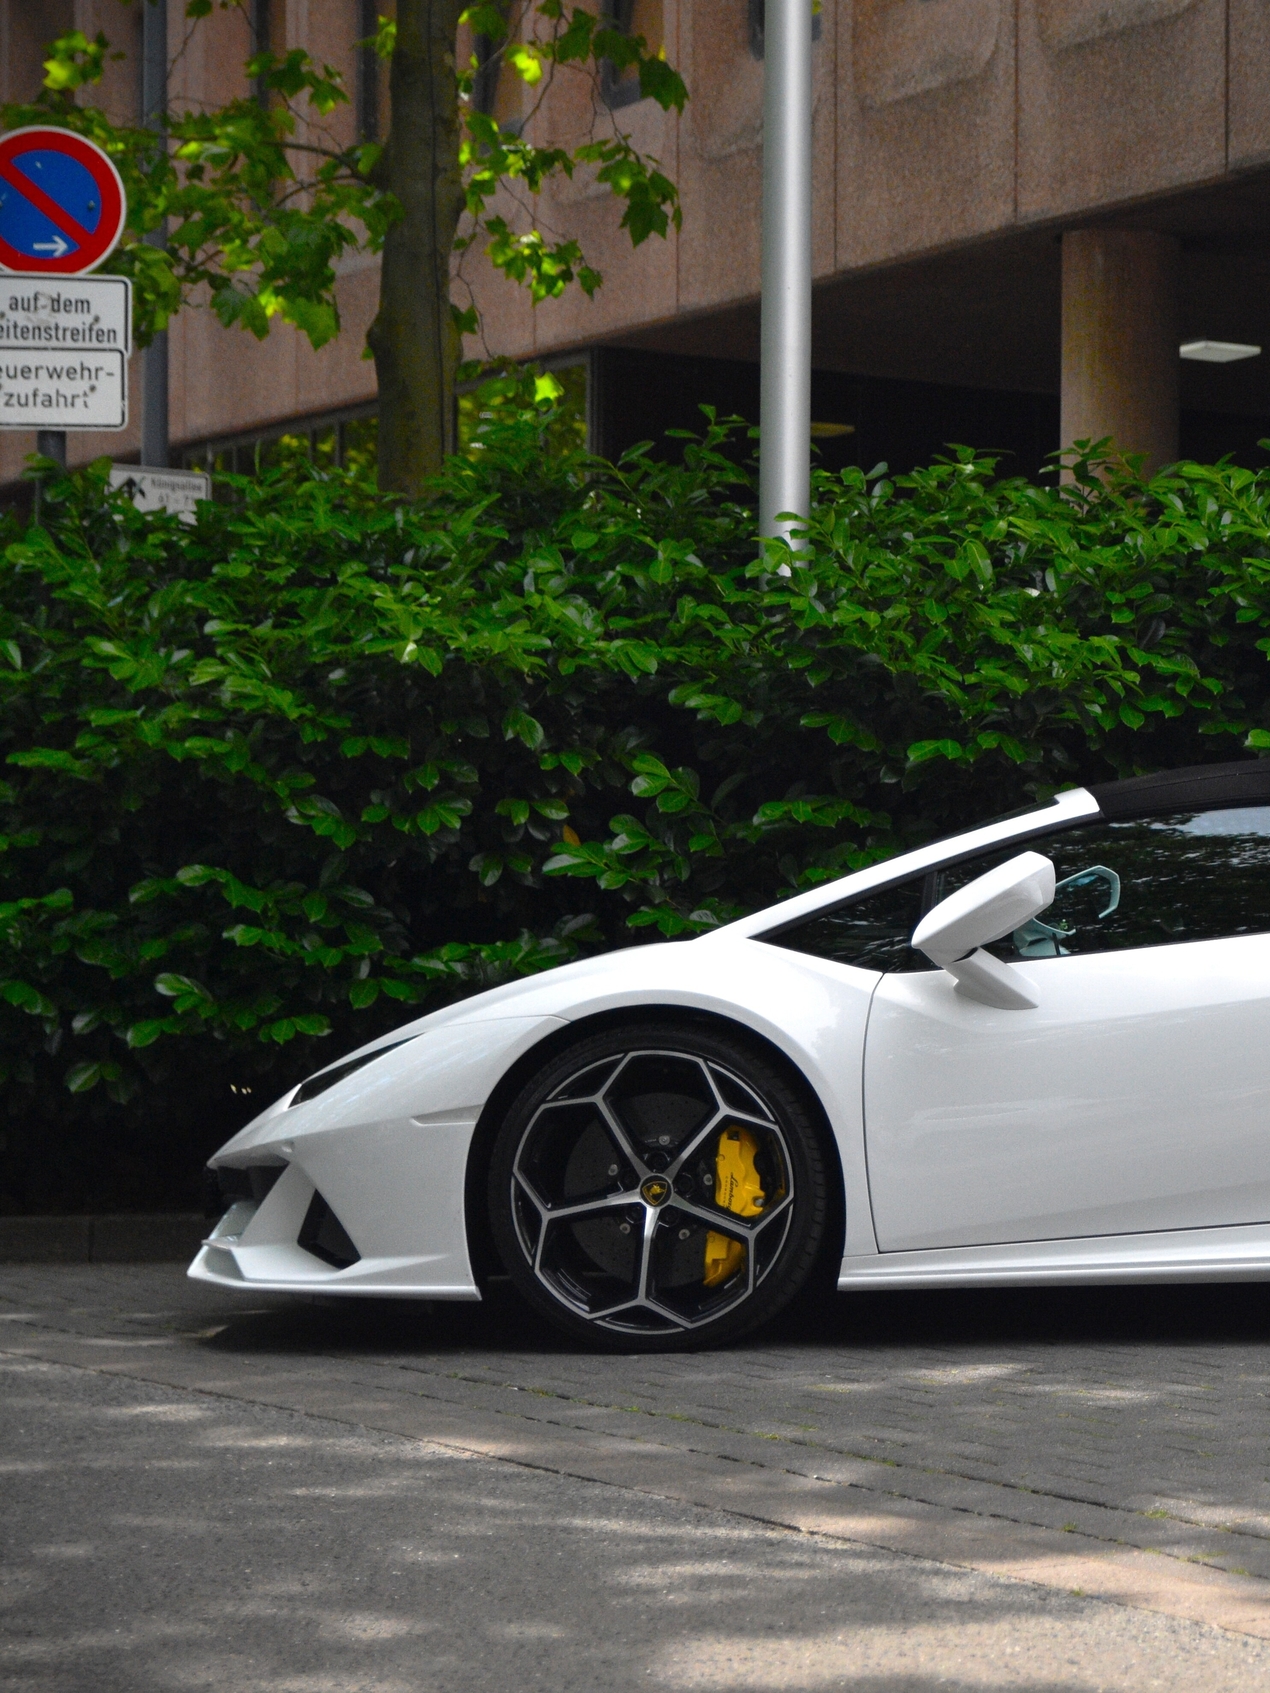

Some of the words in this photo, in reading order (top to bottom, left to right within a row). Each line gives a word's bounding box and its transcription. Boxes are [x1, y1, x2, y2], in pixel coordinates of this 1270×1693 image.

[9, 291, 40, 313] auf
[51, 292, 91, 314] dem
[0, 361, 115, 381] uerwehr-
[4, 388, 89, 409] zufahrt
